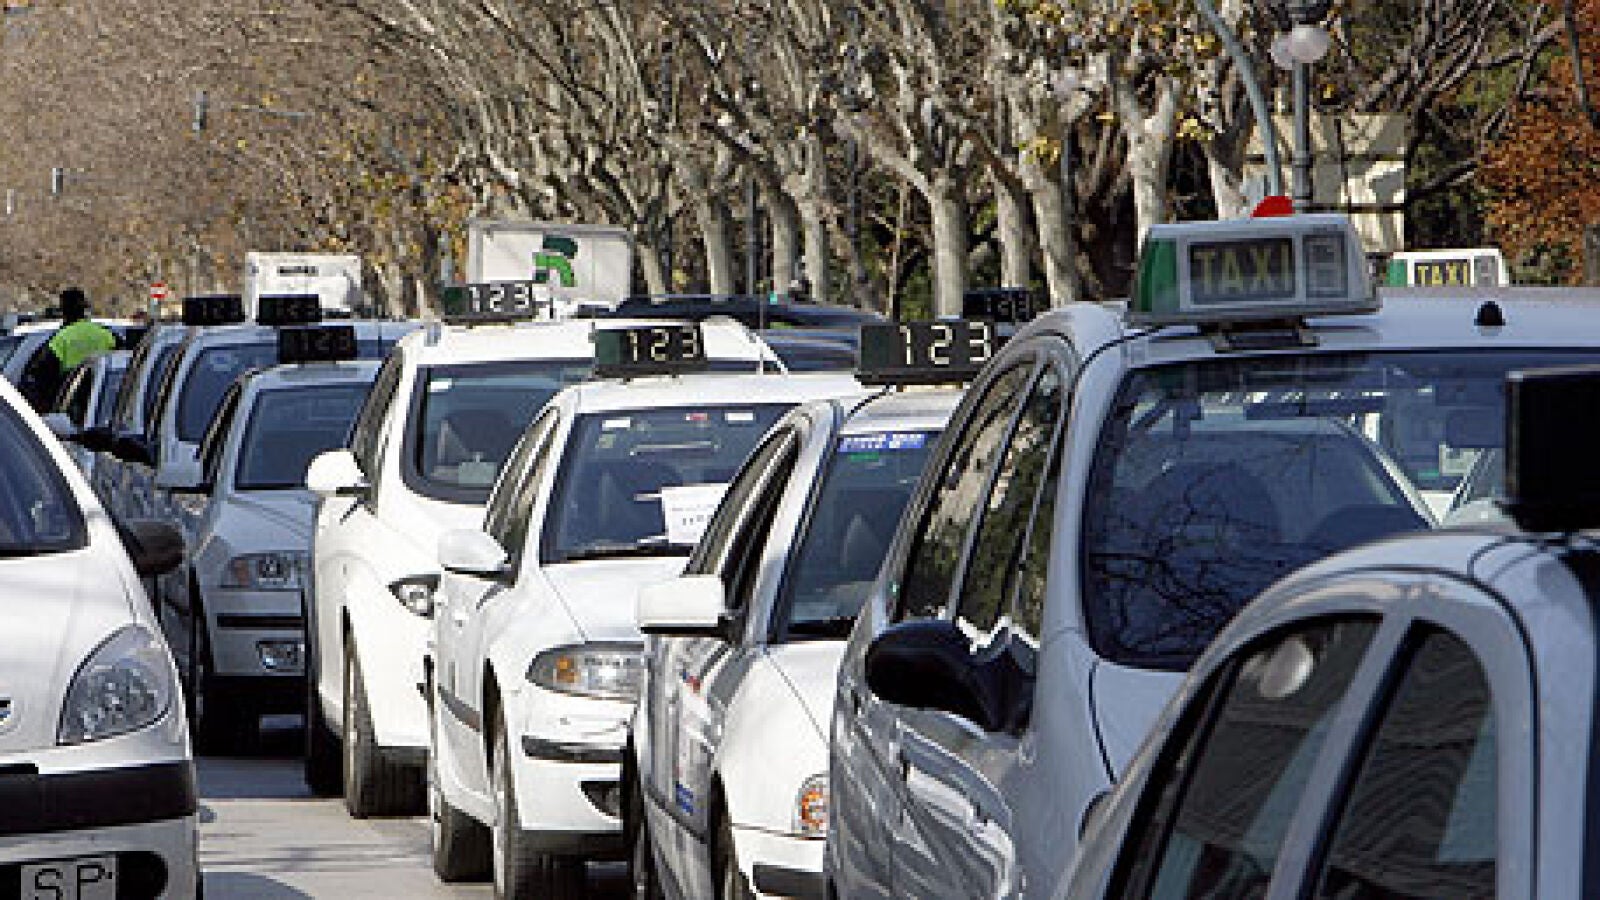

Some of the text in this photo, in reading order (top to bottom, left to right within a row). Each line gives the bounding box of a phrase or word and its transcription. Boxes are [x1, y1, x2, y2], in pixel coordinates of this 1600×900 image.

[1193, 243, 1291, 295] TAXI
[1417, 261, 1468, 285] TAXI
[469, 283, 530, 313] 123
[626, 328, 698, 362] 123
[899, 321, 992, 365] 123
